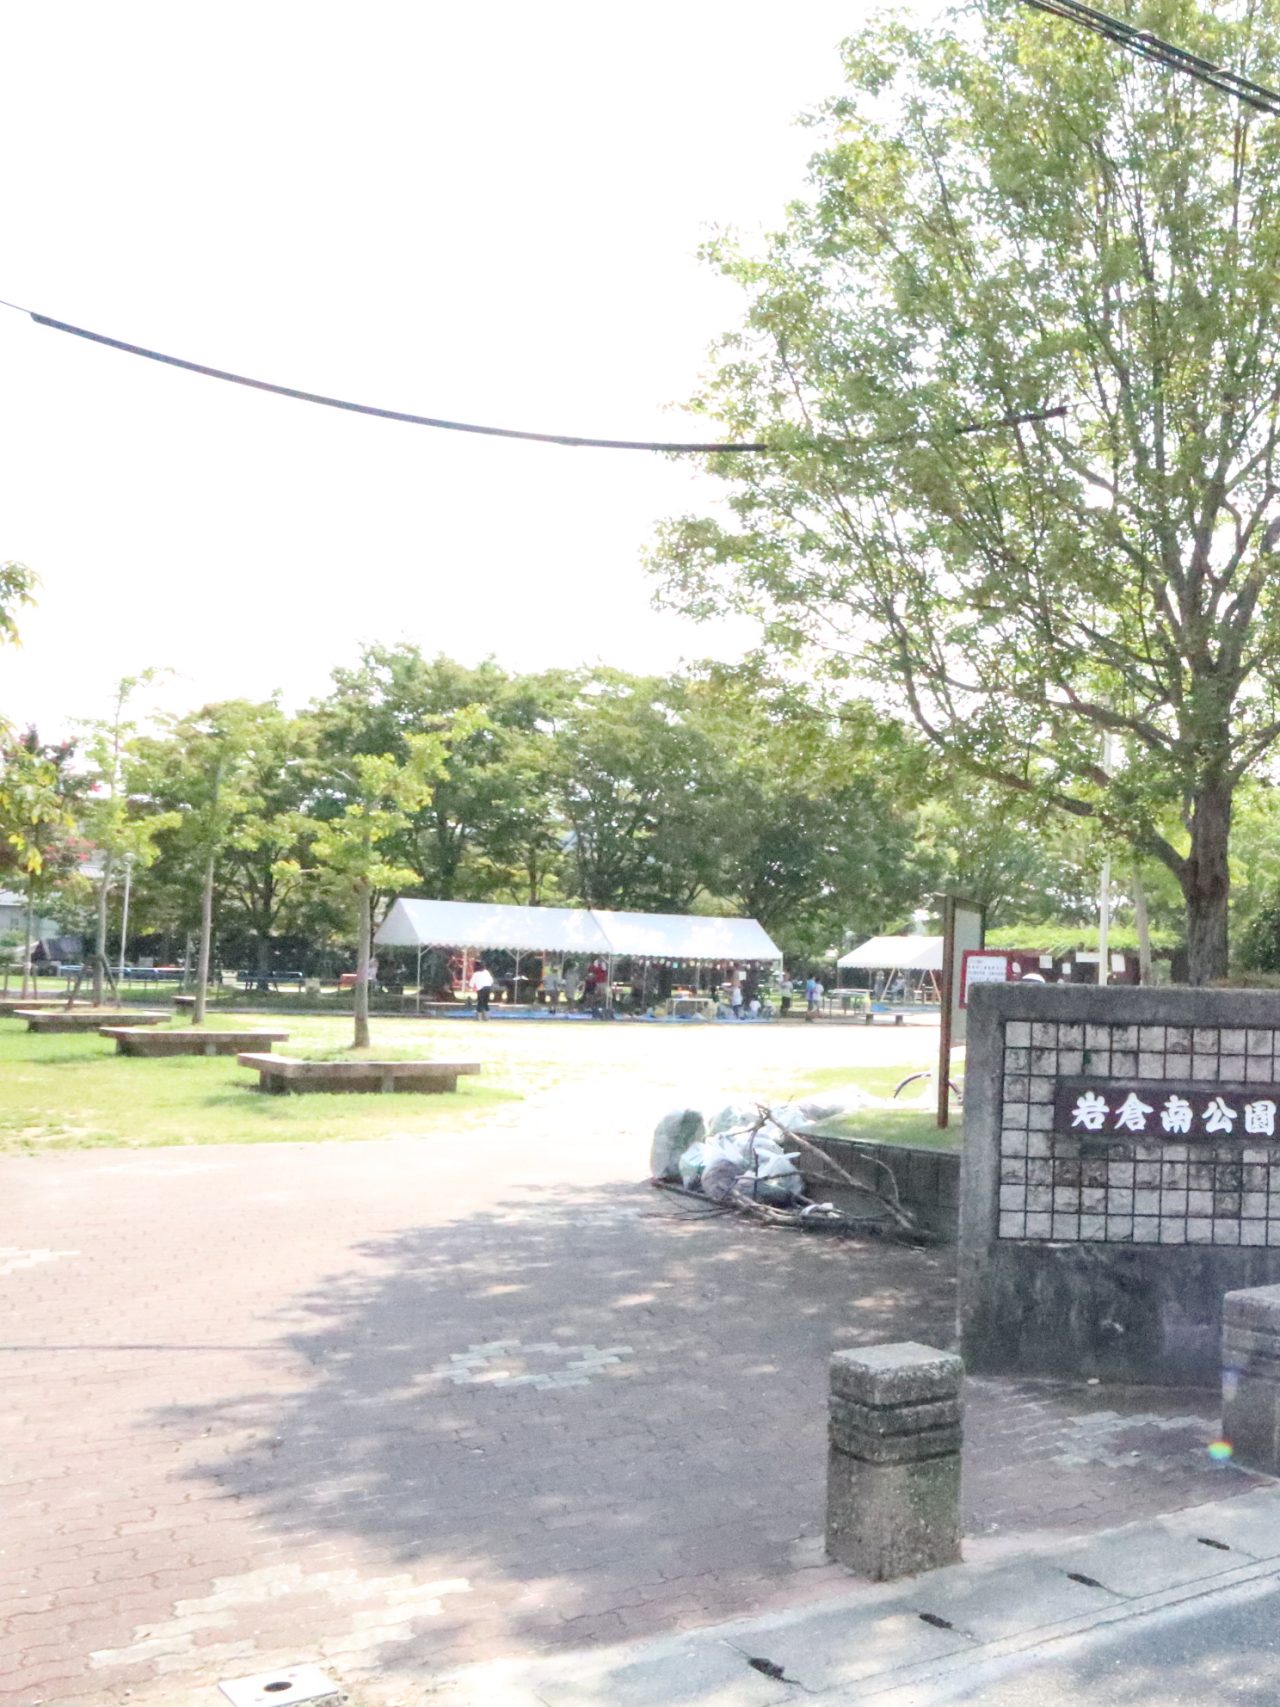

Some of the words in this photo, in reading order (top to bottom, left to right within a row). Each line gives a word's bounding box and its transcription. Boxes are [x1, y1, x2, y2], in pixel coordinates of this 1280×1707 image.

[1071, 1091, 1277, 1136] 岩倉南公園
